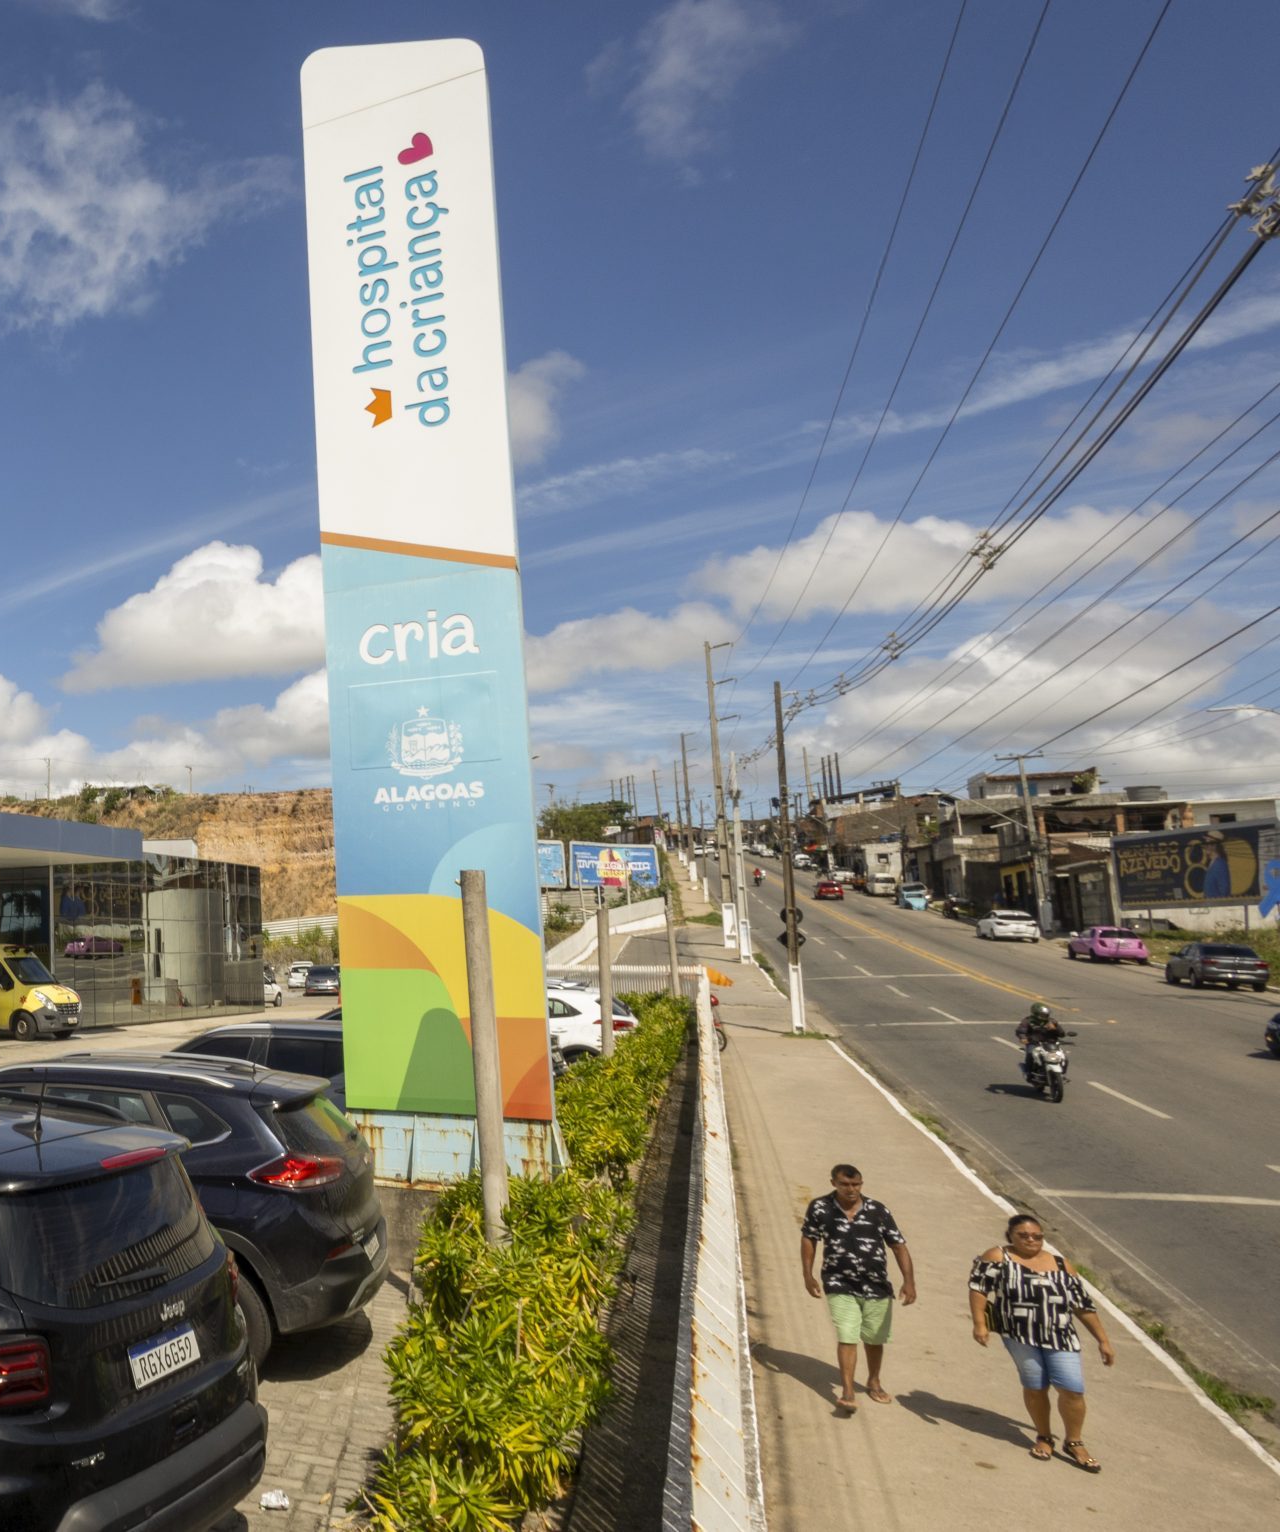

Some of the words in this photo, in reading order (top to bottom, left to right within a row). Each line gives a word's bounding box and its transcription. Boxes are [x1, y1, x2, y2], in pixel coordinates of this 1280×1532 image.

[343, 165, 399, 374] hospital
[399, 170, 449, 357] criança
[404, 366, 450, 427] da
[359, 609, 480, 665] cria
[373, 780, 485, 804] ALAGOAS
[382, 799, 476, 812] GOVERNO
[1120, 855, 1181, 877] AZEVEDO
[160, 1300, 185, 1321] Jeep
[139, 1336, 192, 1381] RGX6G59
